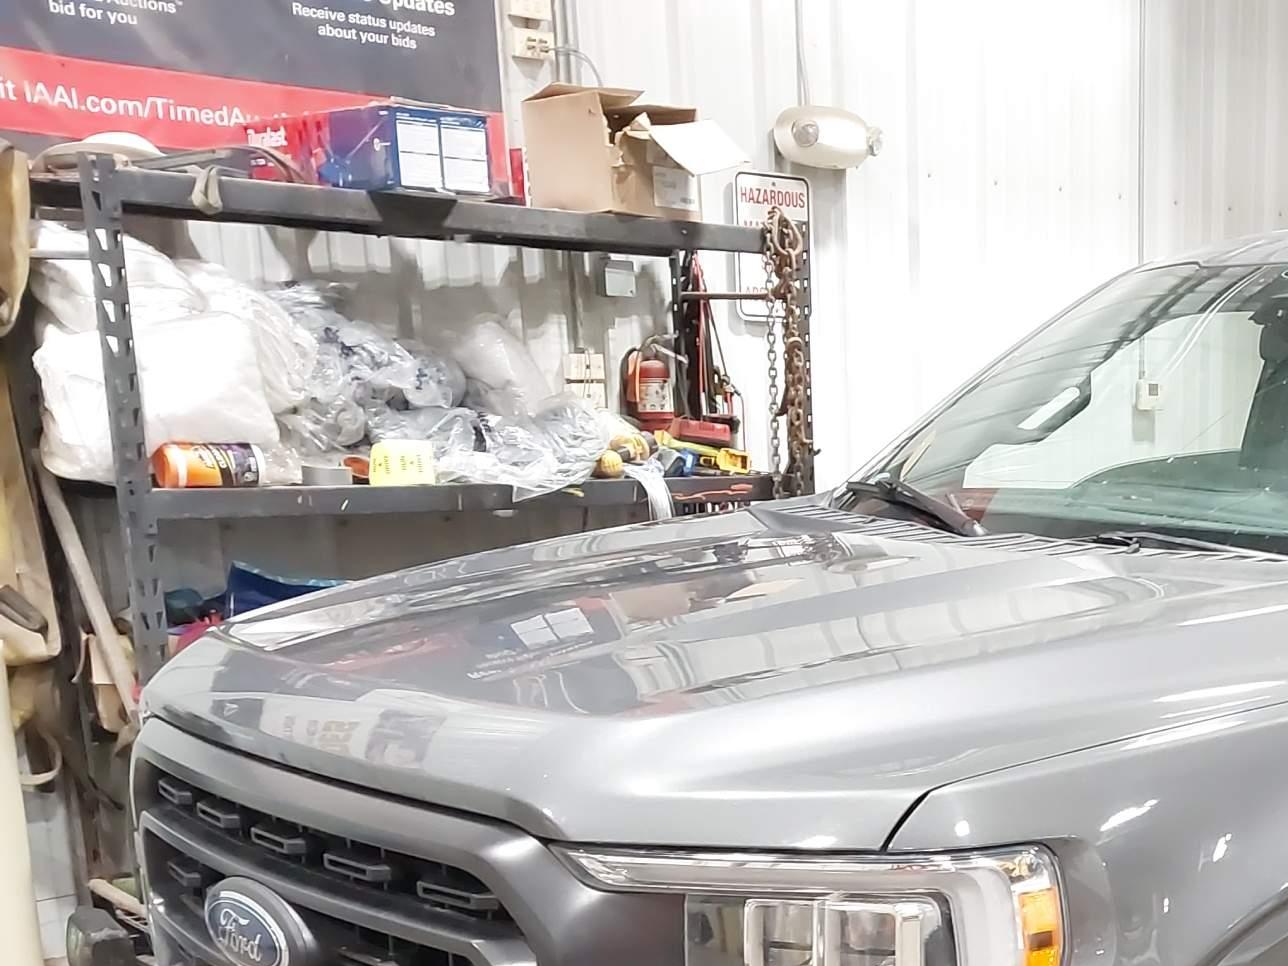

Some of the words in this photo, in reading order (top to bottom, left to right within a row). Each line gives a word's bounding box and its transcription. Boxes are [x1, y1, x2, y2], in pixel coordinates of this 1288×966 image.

[49, 1, 75, 16] bid
[79, 4, 104, 19] for
[107, 10, 138, 25] you
[292, 2, 346, 22] Receive
[348, 12, 387, 29] status
[389, 20, 436, 37] updates
[318, 24, 357, 40] about
[359, 30, 389, 45] your
[391, 33, 417, 49] bids
[740, 186, 806, 209] HAZARDOUS
[218, 907, 262, 962] Ford
